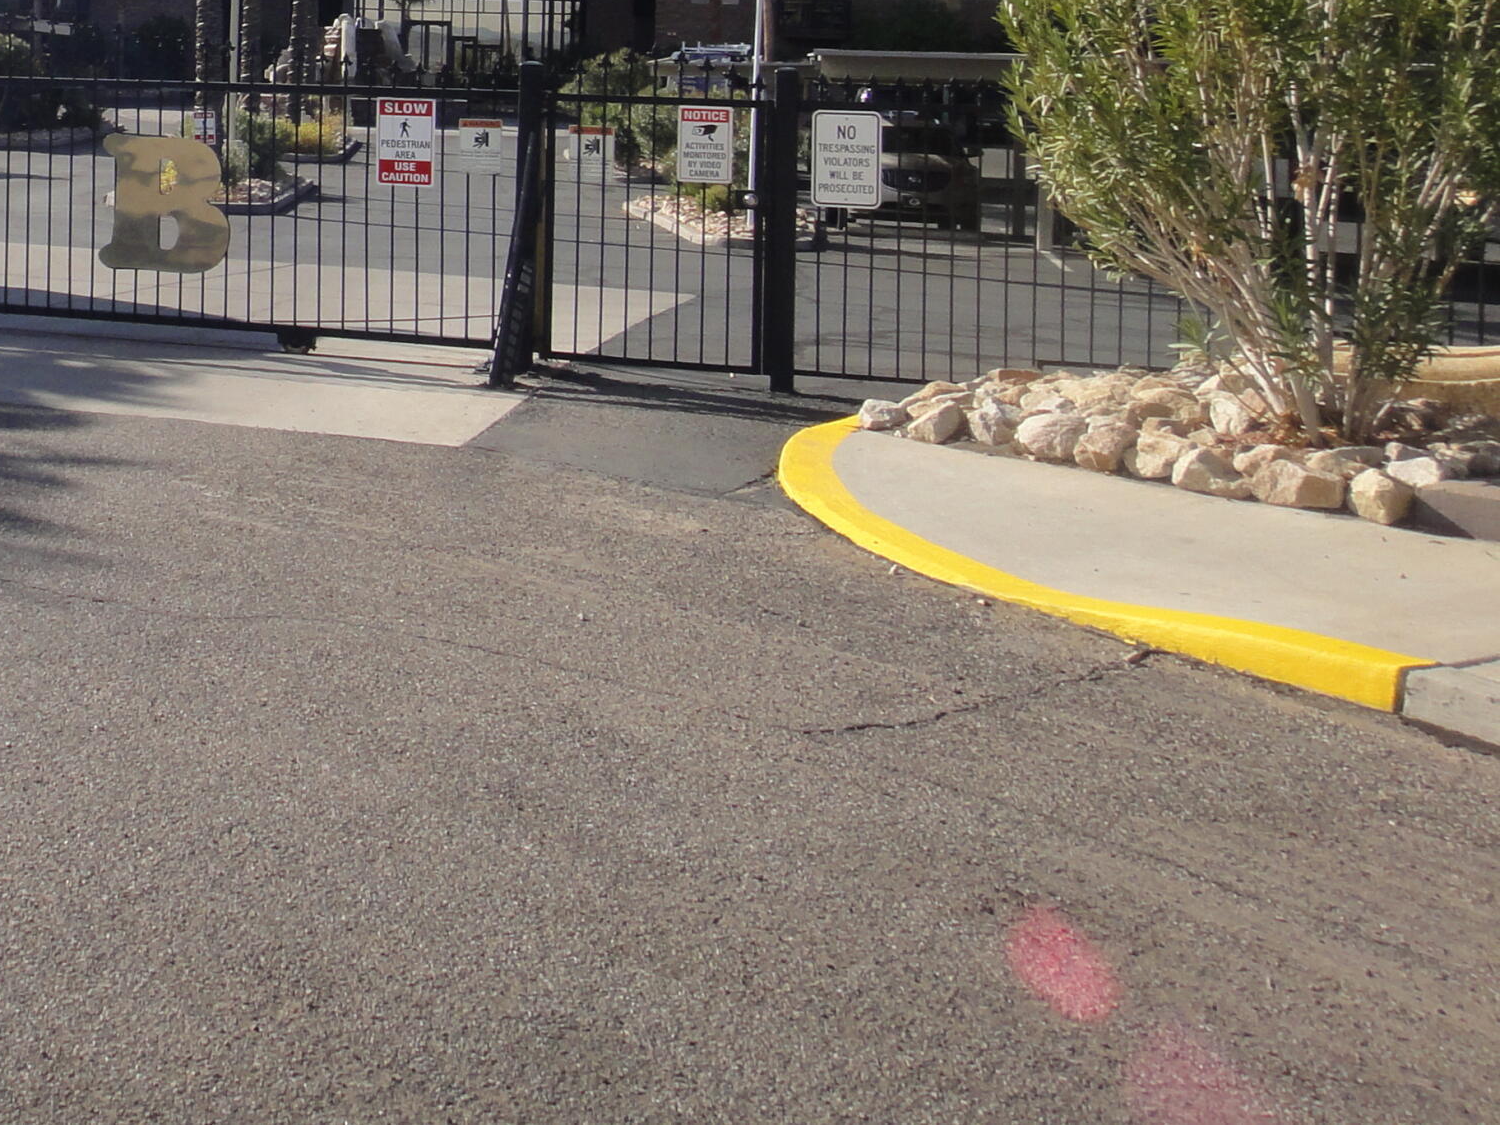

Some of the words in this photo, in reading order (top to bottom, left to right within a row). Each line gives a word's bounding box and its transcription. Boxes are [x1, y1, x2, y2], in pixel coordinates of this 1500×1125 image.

[384, 102, 428, 114] SLOW
[683, 110, 727, 121] NOTICE
[837, 125, 856, 140] NO
[381, 139, 430, 149] PEDESTRIAN
[685, 142, 724, 151] ACTIVITIES
[818, 143, 876, 154] TRESPASSING
[394, 151, 416, 159] AREA
[683, 152, 726, 160] MONITORED
[394, 162, 416, 172] USE
[700, 161, 721, 169] VIDEO
[823, 157, 870, 168] VIOLATORS
[382, 172, 429, 183] CAUTION
[689, 170, 720, 178] CAMERA
[829, 171, 849, 180] WILL
[852, 171, 864, 181] BE
[818, 183, 875, 195] PROSECUTED
[98, 133, 231, 274] B
